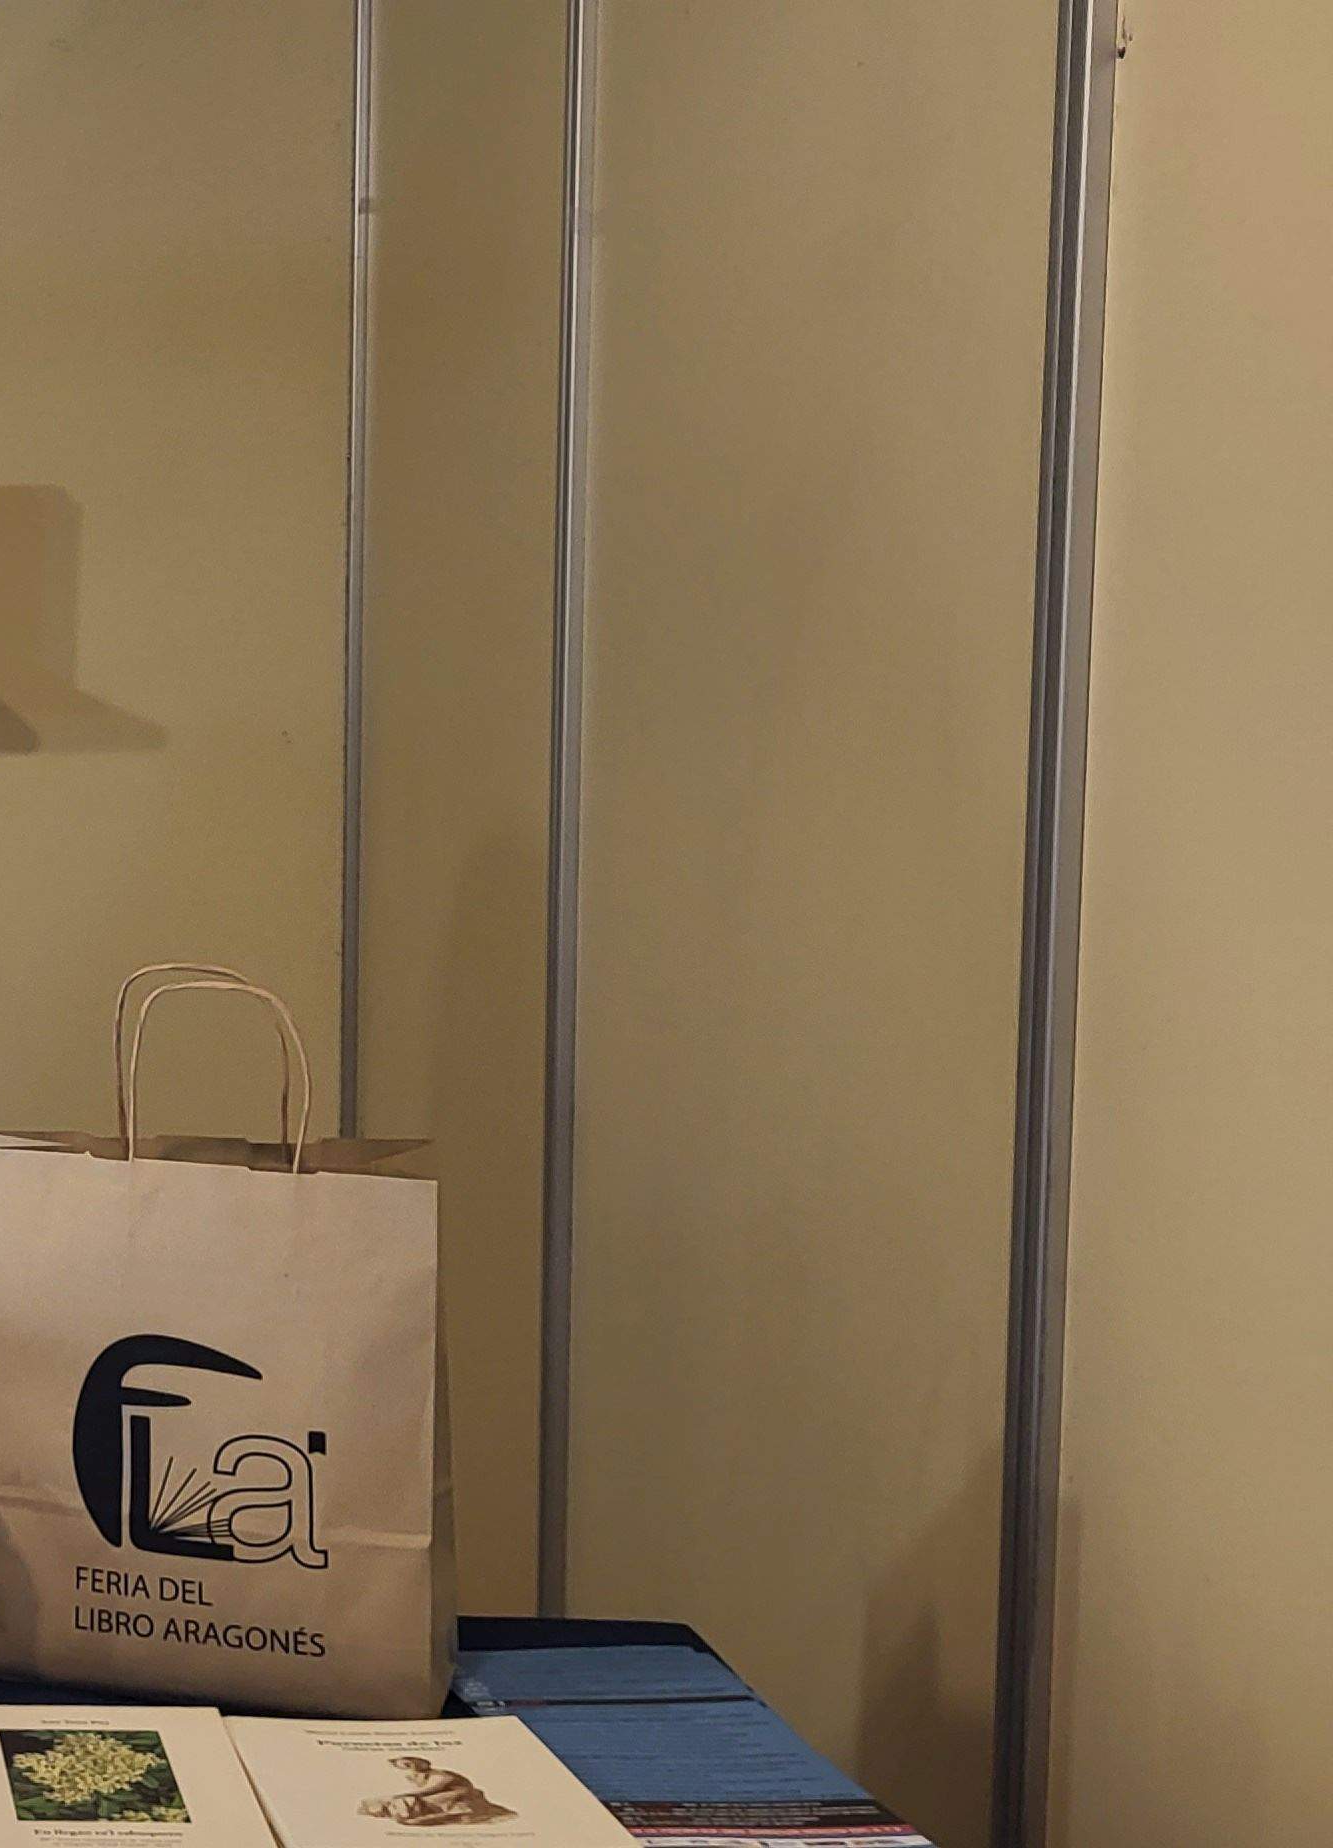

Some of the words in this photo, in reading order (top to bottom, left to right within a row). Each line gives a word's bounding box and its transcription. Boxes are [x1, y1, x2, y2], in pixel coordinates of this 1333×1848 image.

[75, 1566, 149, 1598] FERIA
[159, 1578, 213, 1606] DEL
[75, 1606, 153, 1639] LIBRO
[163, 1617, 326, 1658] ARAGONÉS
